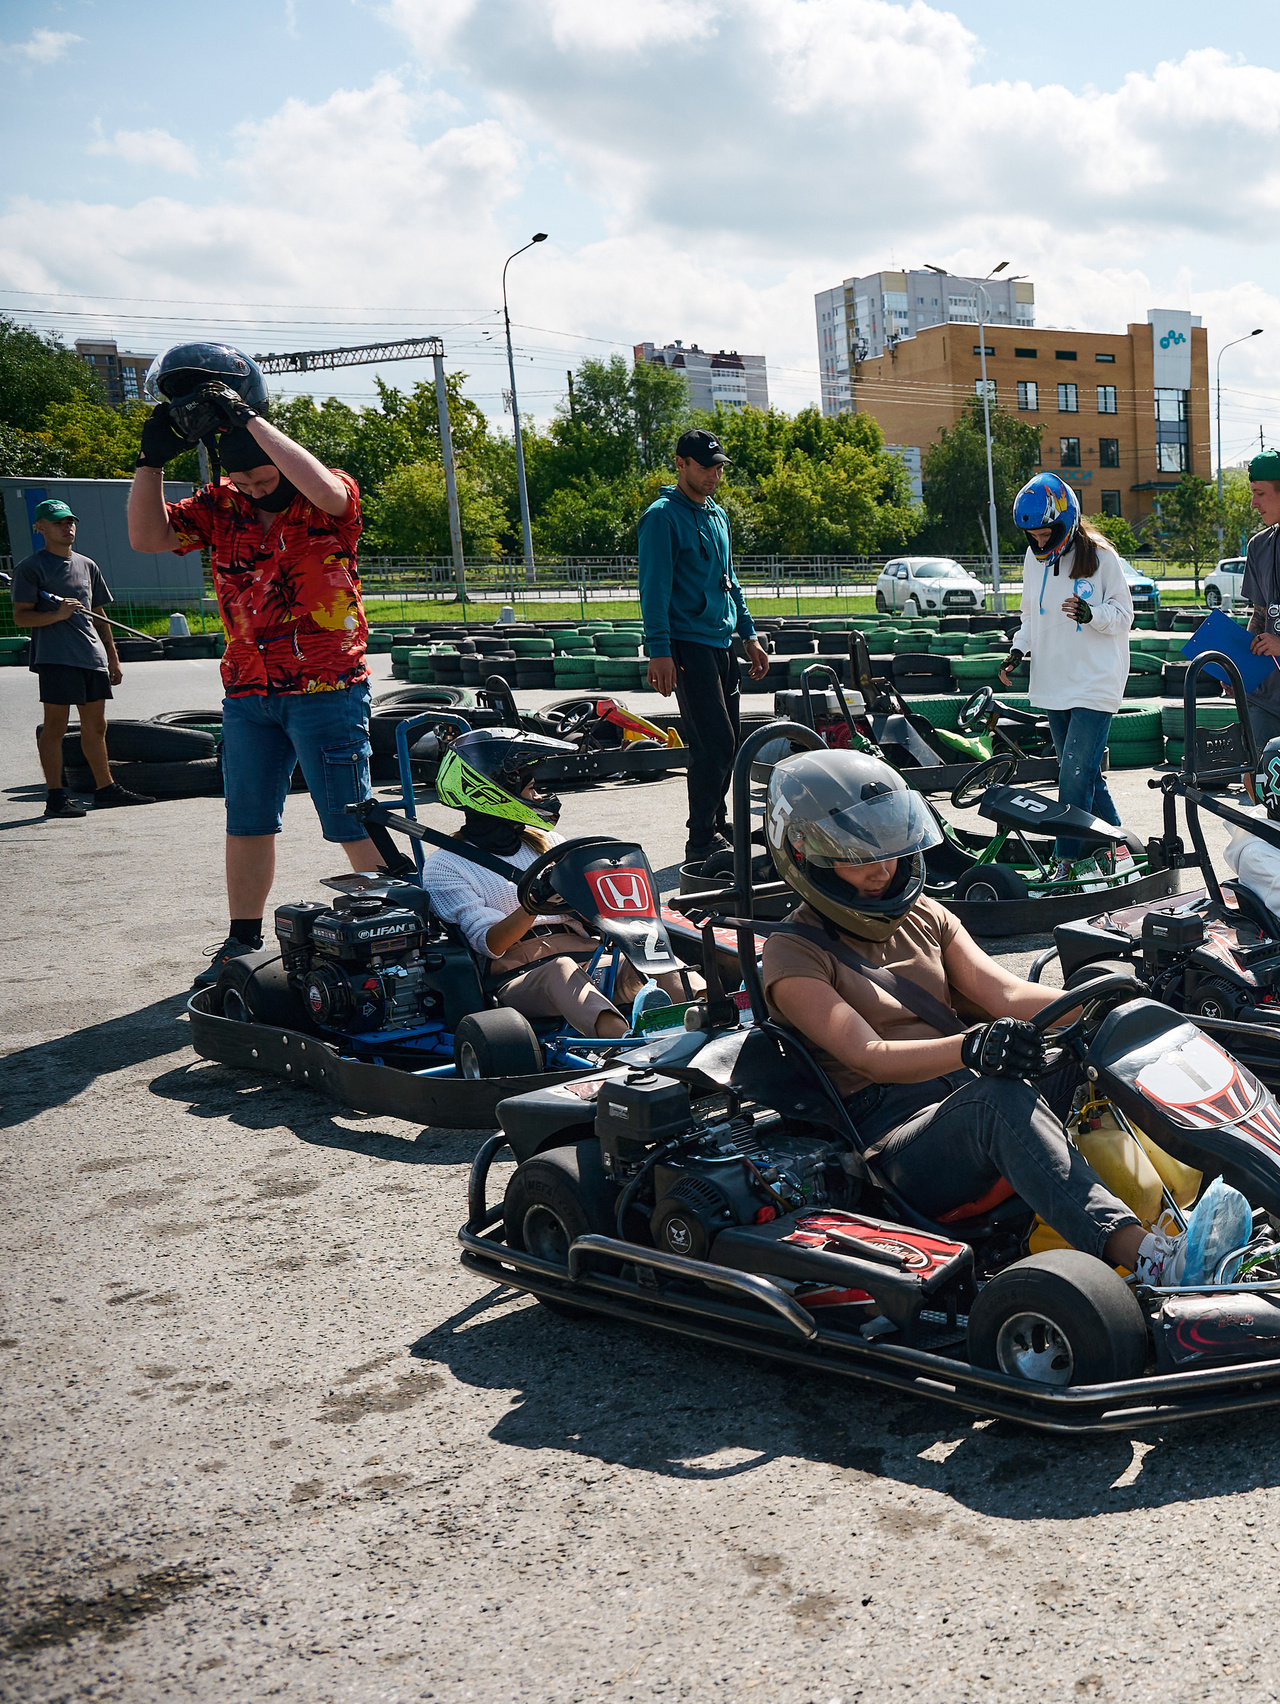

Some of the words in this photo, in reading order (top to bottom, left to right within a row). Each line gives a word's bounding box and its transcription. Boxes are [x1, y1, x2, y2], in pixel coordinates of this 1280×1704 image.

[768, 794, 794, 850] 5
[1010, 795, 1048, 813] 5
[369, 924, 405, 938] LIFAN
[629, 920, 671, 961] 2
[1165, 1051, 1213, 1093] 1
